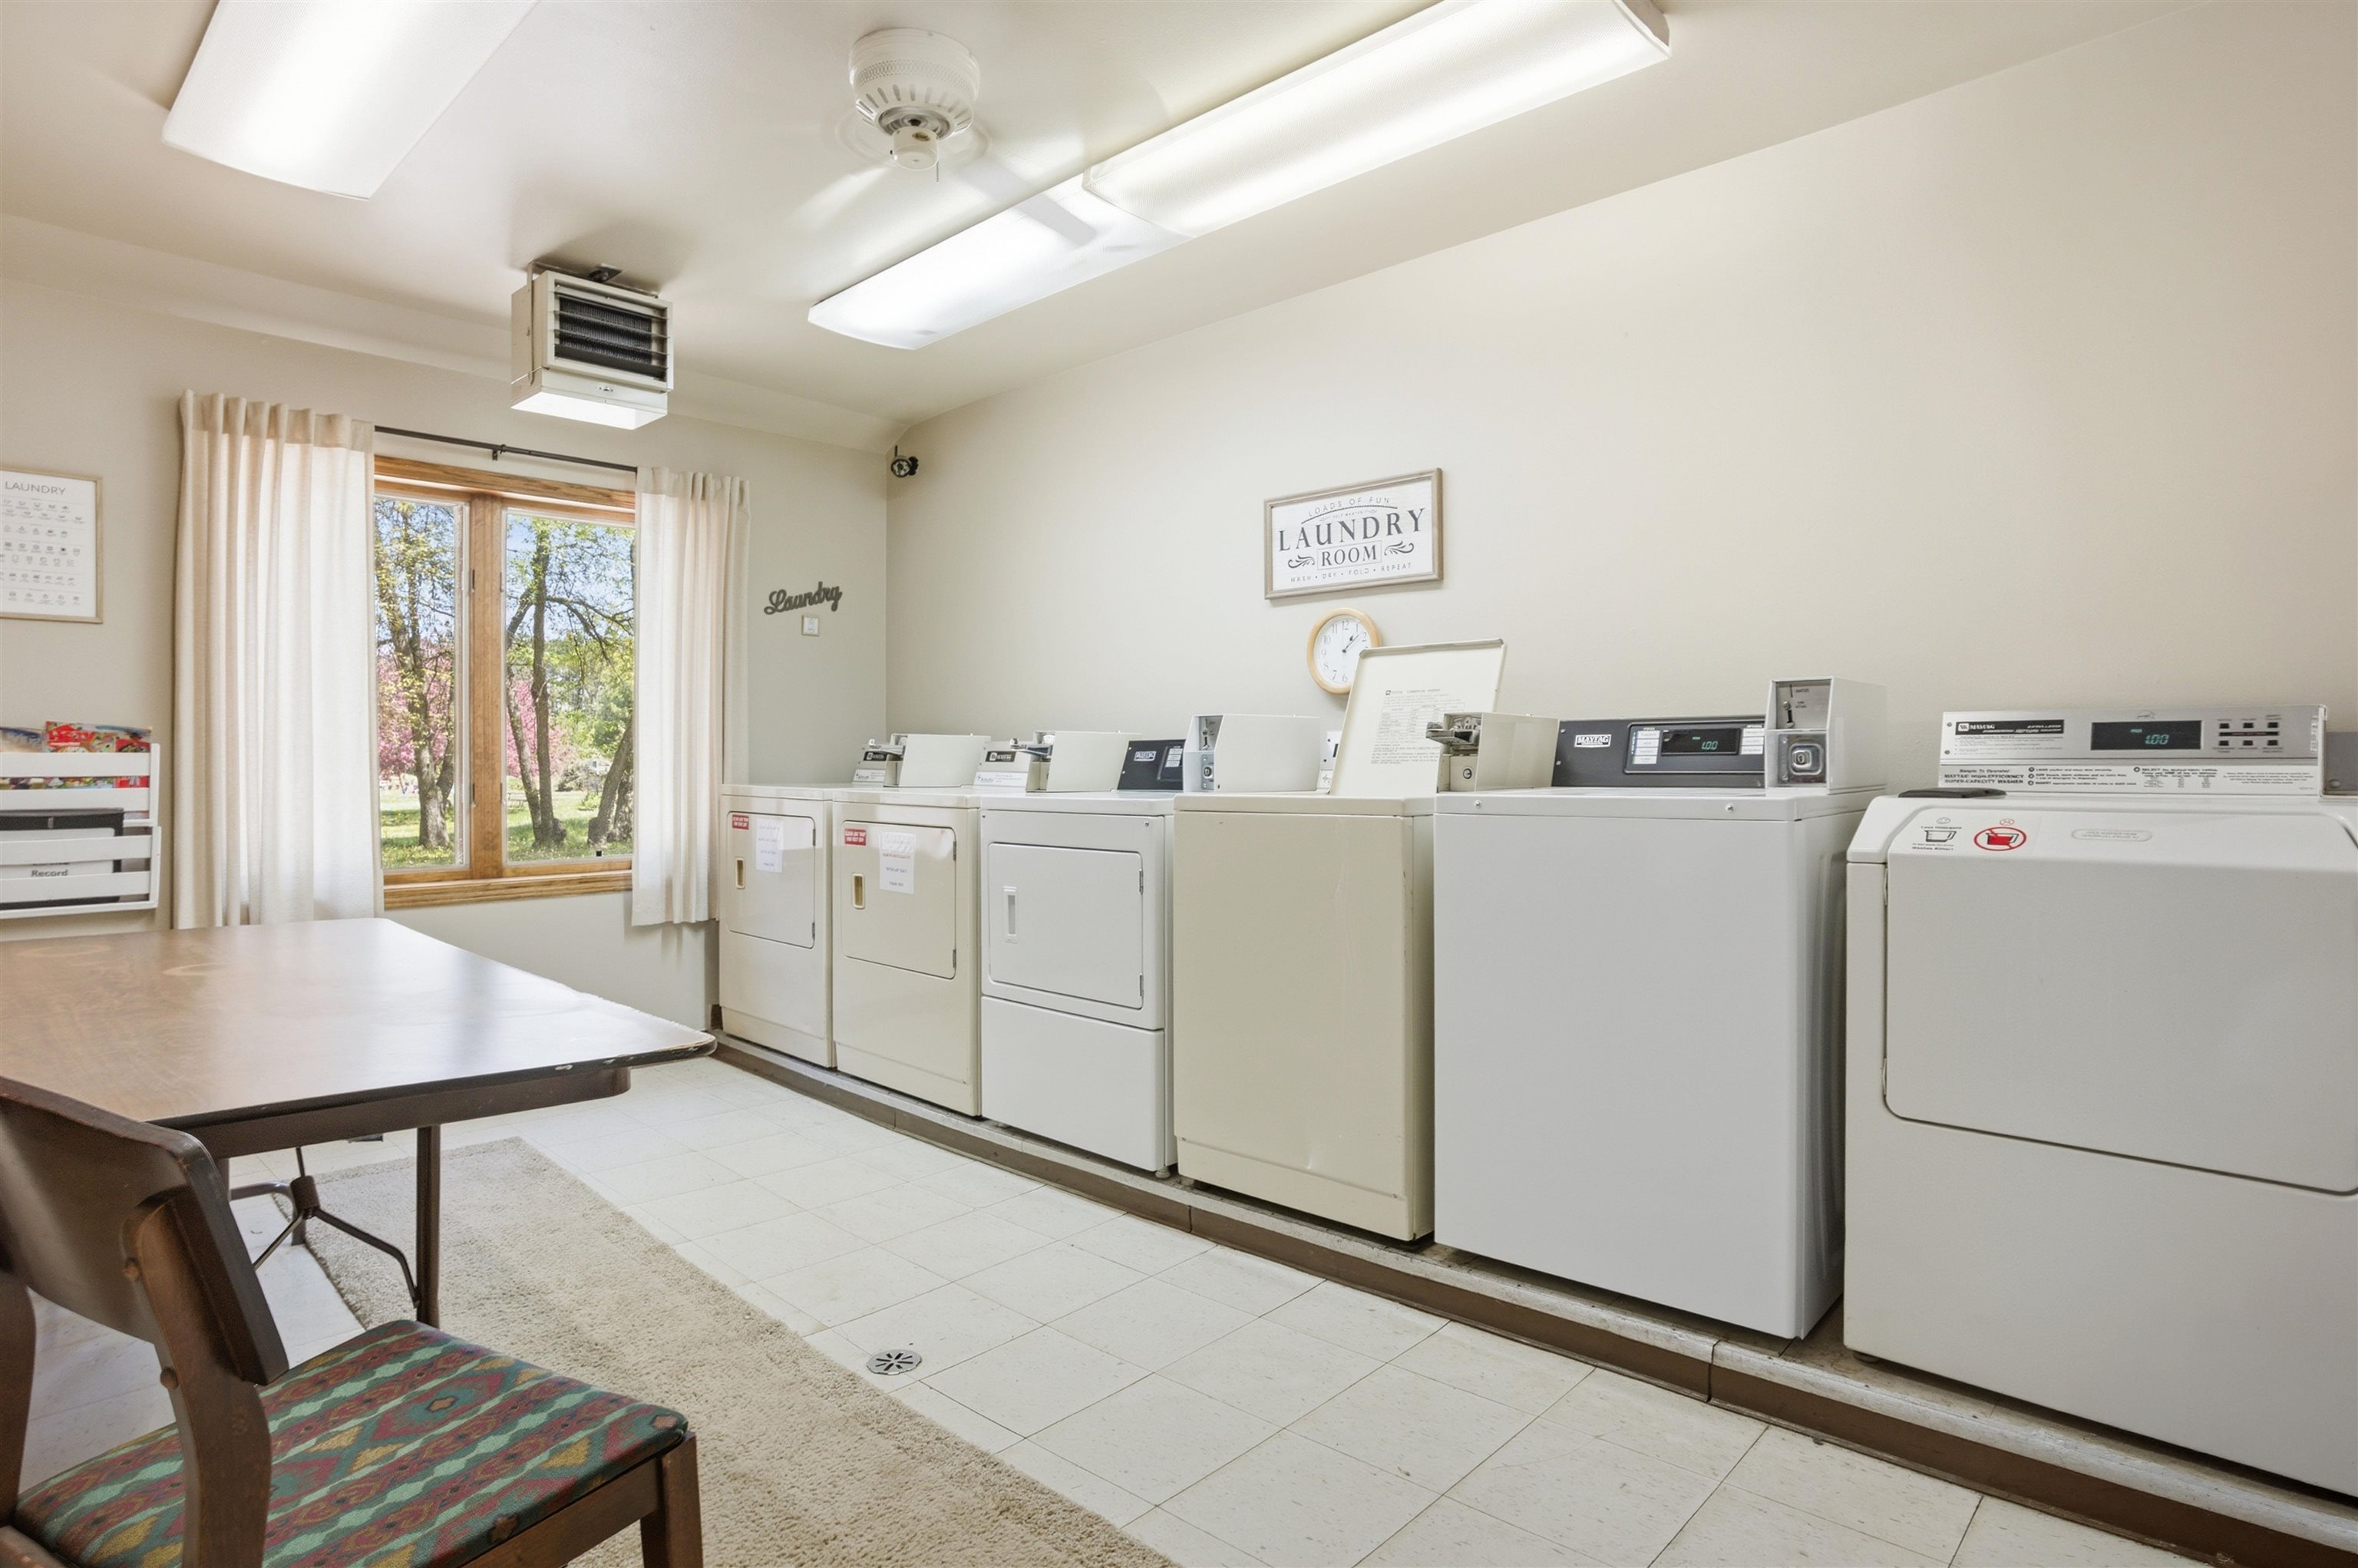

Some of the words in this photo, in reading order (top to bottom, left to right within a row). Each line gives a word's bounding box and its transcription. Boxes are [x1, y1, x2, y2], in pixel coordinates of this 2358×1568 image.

[5, 481, 66, 495] LAUNDRY
[1308, 501, 1342, 517] LOADS
[1279, 508, 1425, 552] LAUNDRY
[1322, 545, 1376, 566] ROOM
[1381, 563, 1412, 573] REPEAT
[764, 581, 843, 615] Laundry
[1342, 620, 1349, 631] 12
[1323, 635, 1331, 645] 10
[1362, 632, 1367, 642] 2
[1333, 669, 1338, 680] 7
[31, 869, 68, 877] Record
